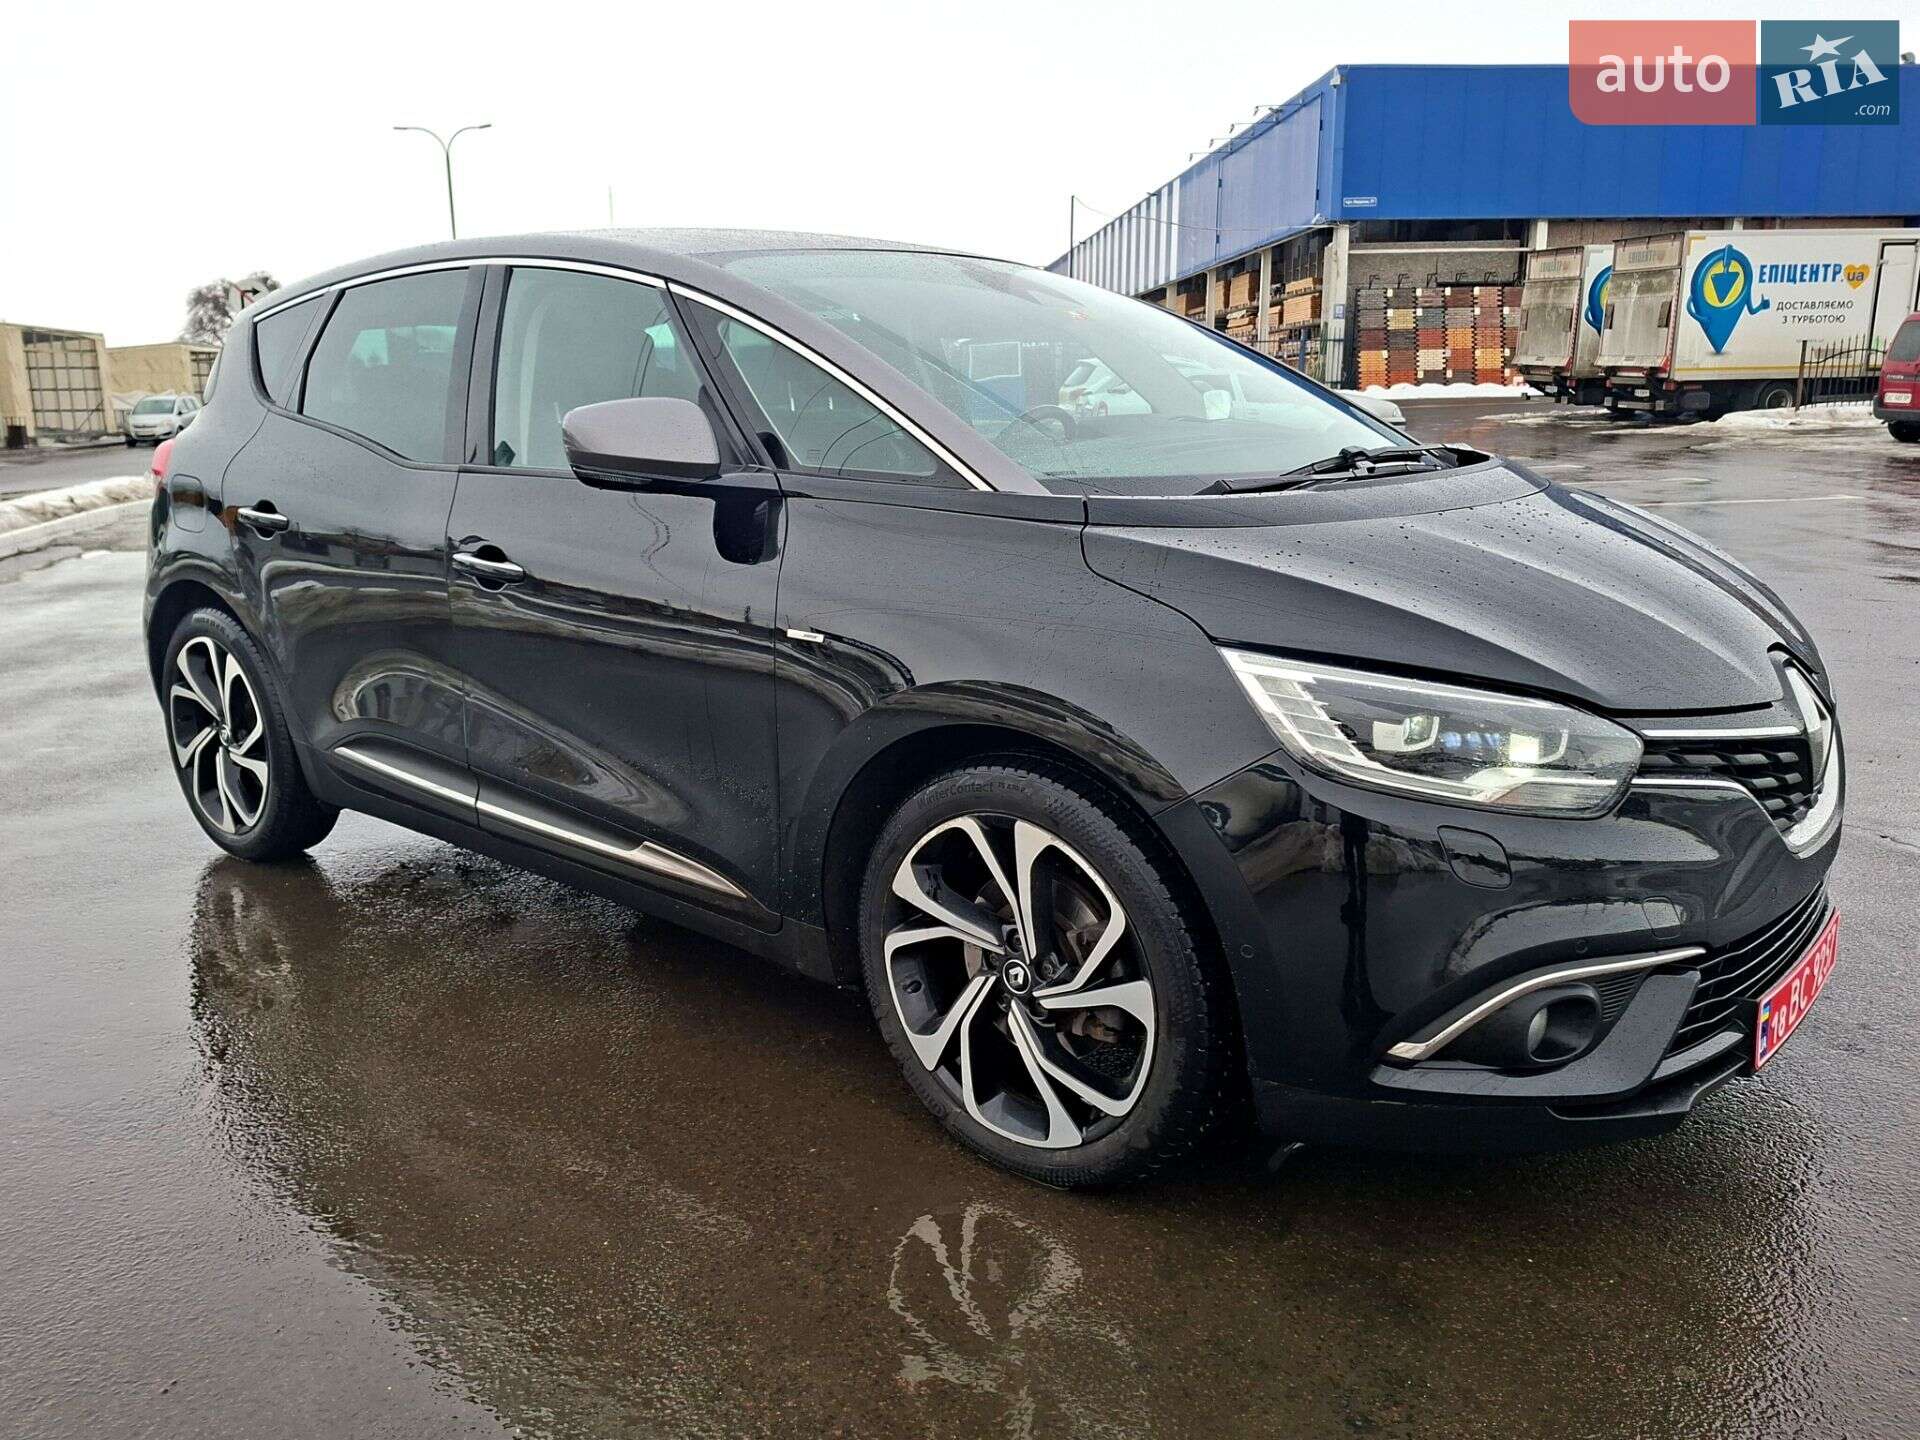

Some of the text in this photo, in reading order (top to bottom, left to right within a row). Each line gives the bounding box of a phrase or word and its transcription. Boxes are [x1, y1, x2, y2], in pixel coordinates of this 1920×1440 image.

[1776, 300, 1855, 313] ДОСТАВЛЯЄМО
[1791, 313, 1846, 325] ТУРБОТОЮ
[1771, 1004, 1788, 1045] 18
[1788, 966, 1811, 1026] BC
